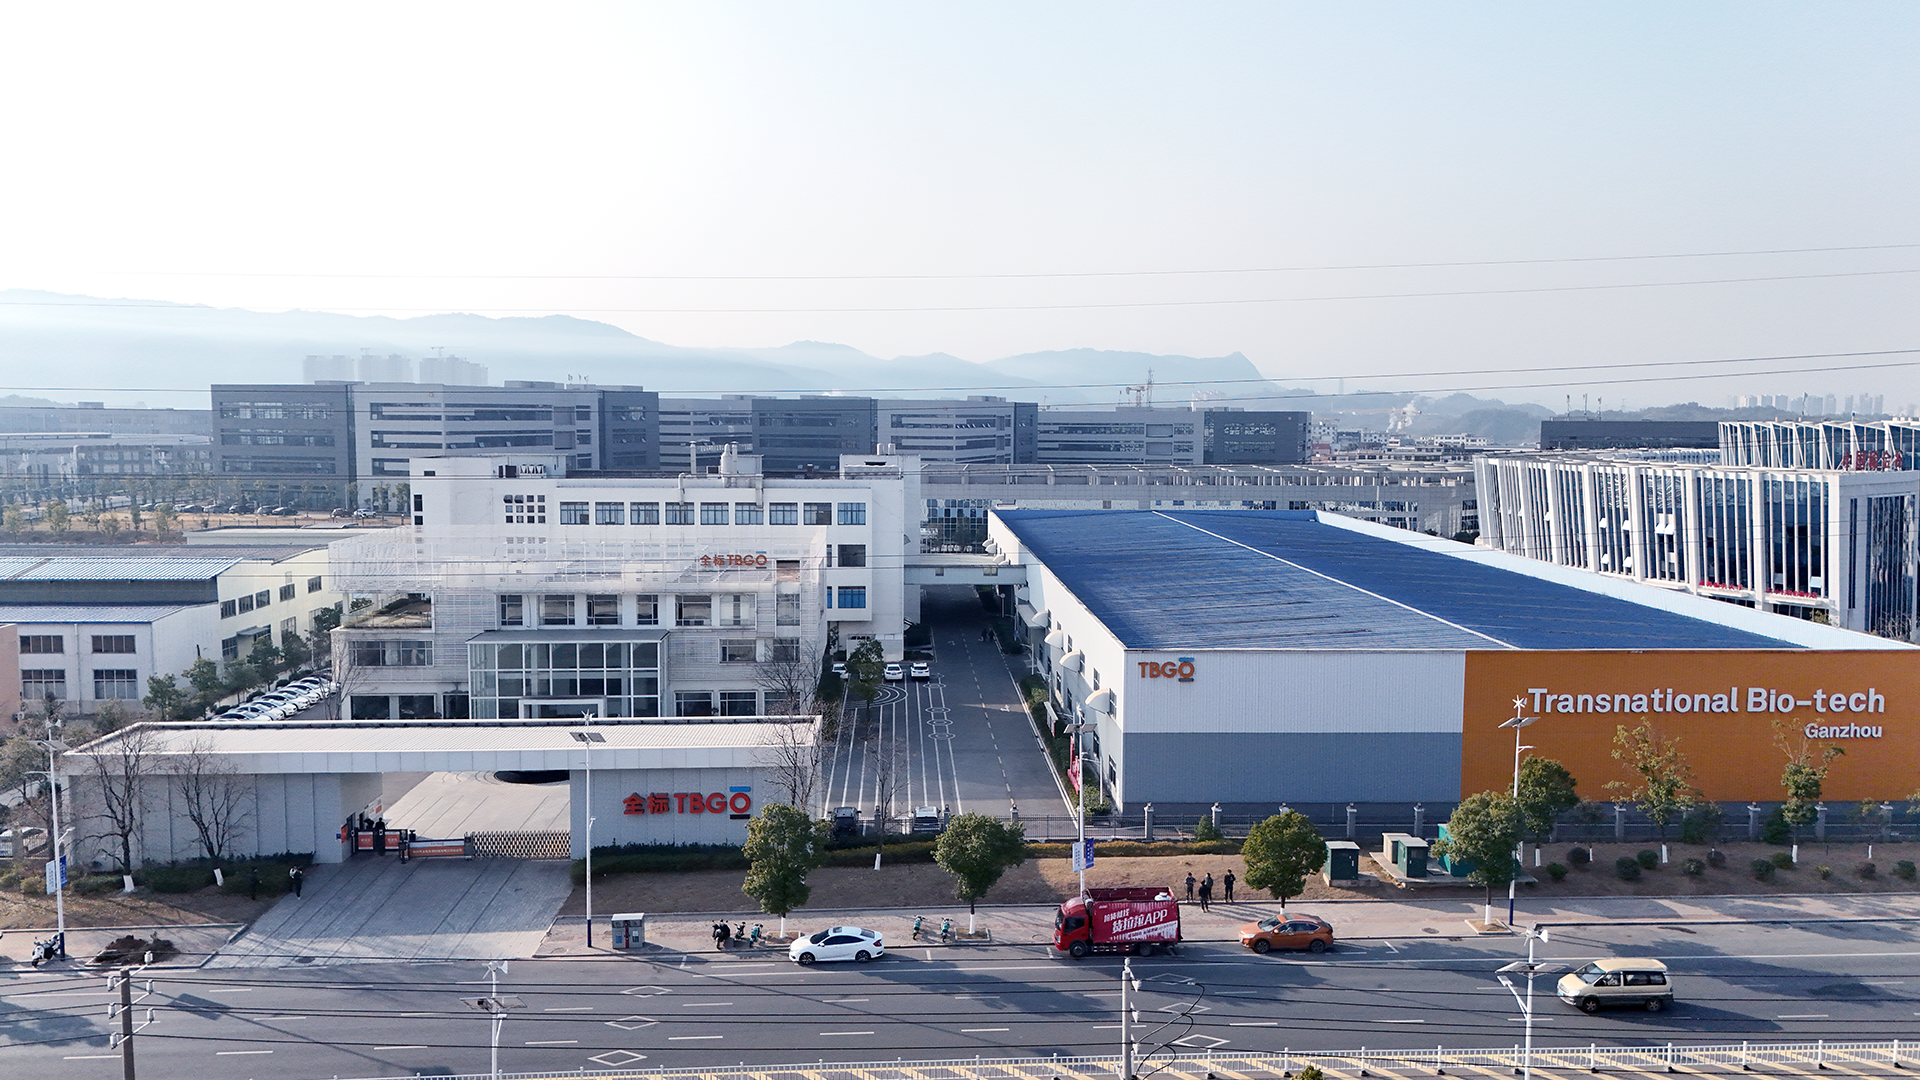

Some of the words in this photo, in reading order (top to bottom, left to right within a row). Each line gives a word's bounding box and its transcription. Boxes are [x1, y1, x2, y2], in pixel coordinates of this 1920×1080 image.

[1138, 657, 1195, 682] TBGO
[1527, 687, 1739, 714] Transnational
[1746, 687, 1886, 714] Bio-tech
[1804, 722, 1883, 740] Ganzhou
